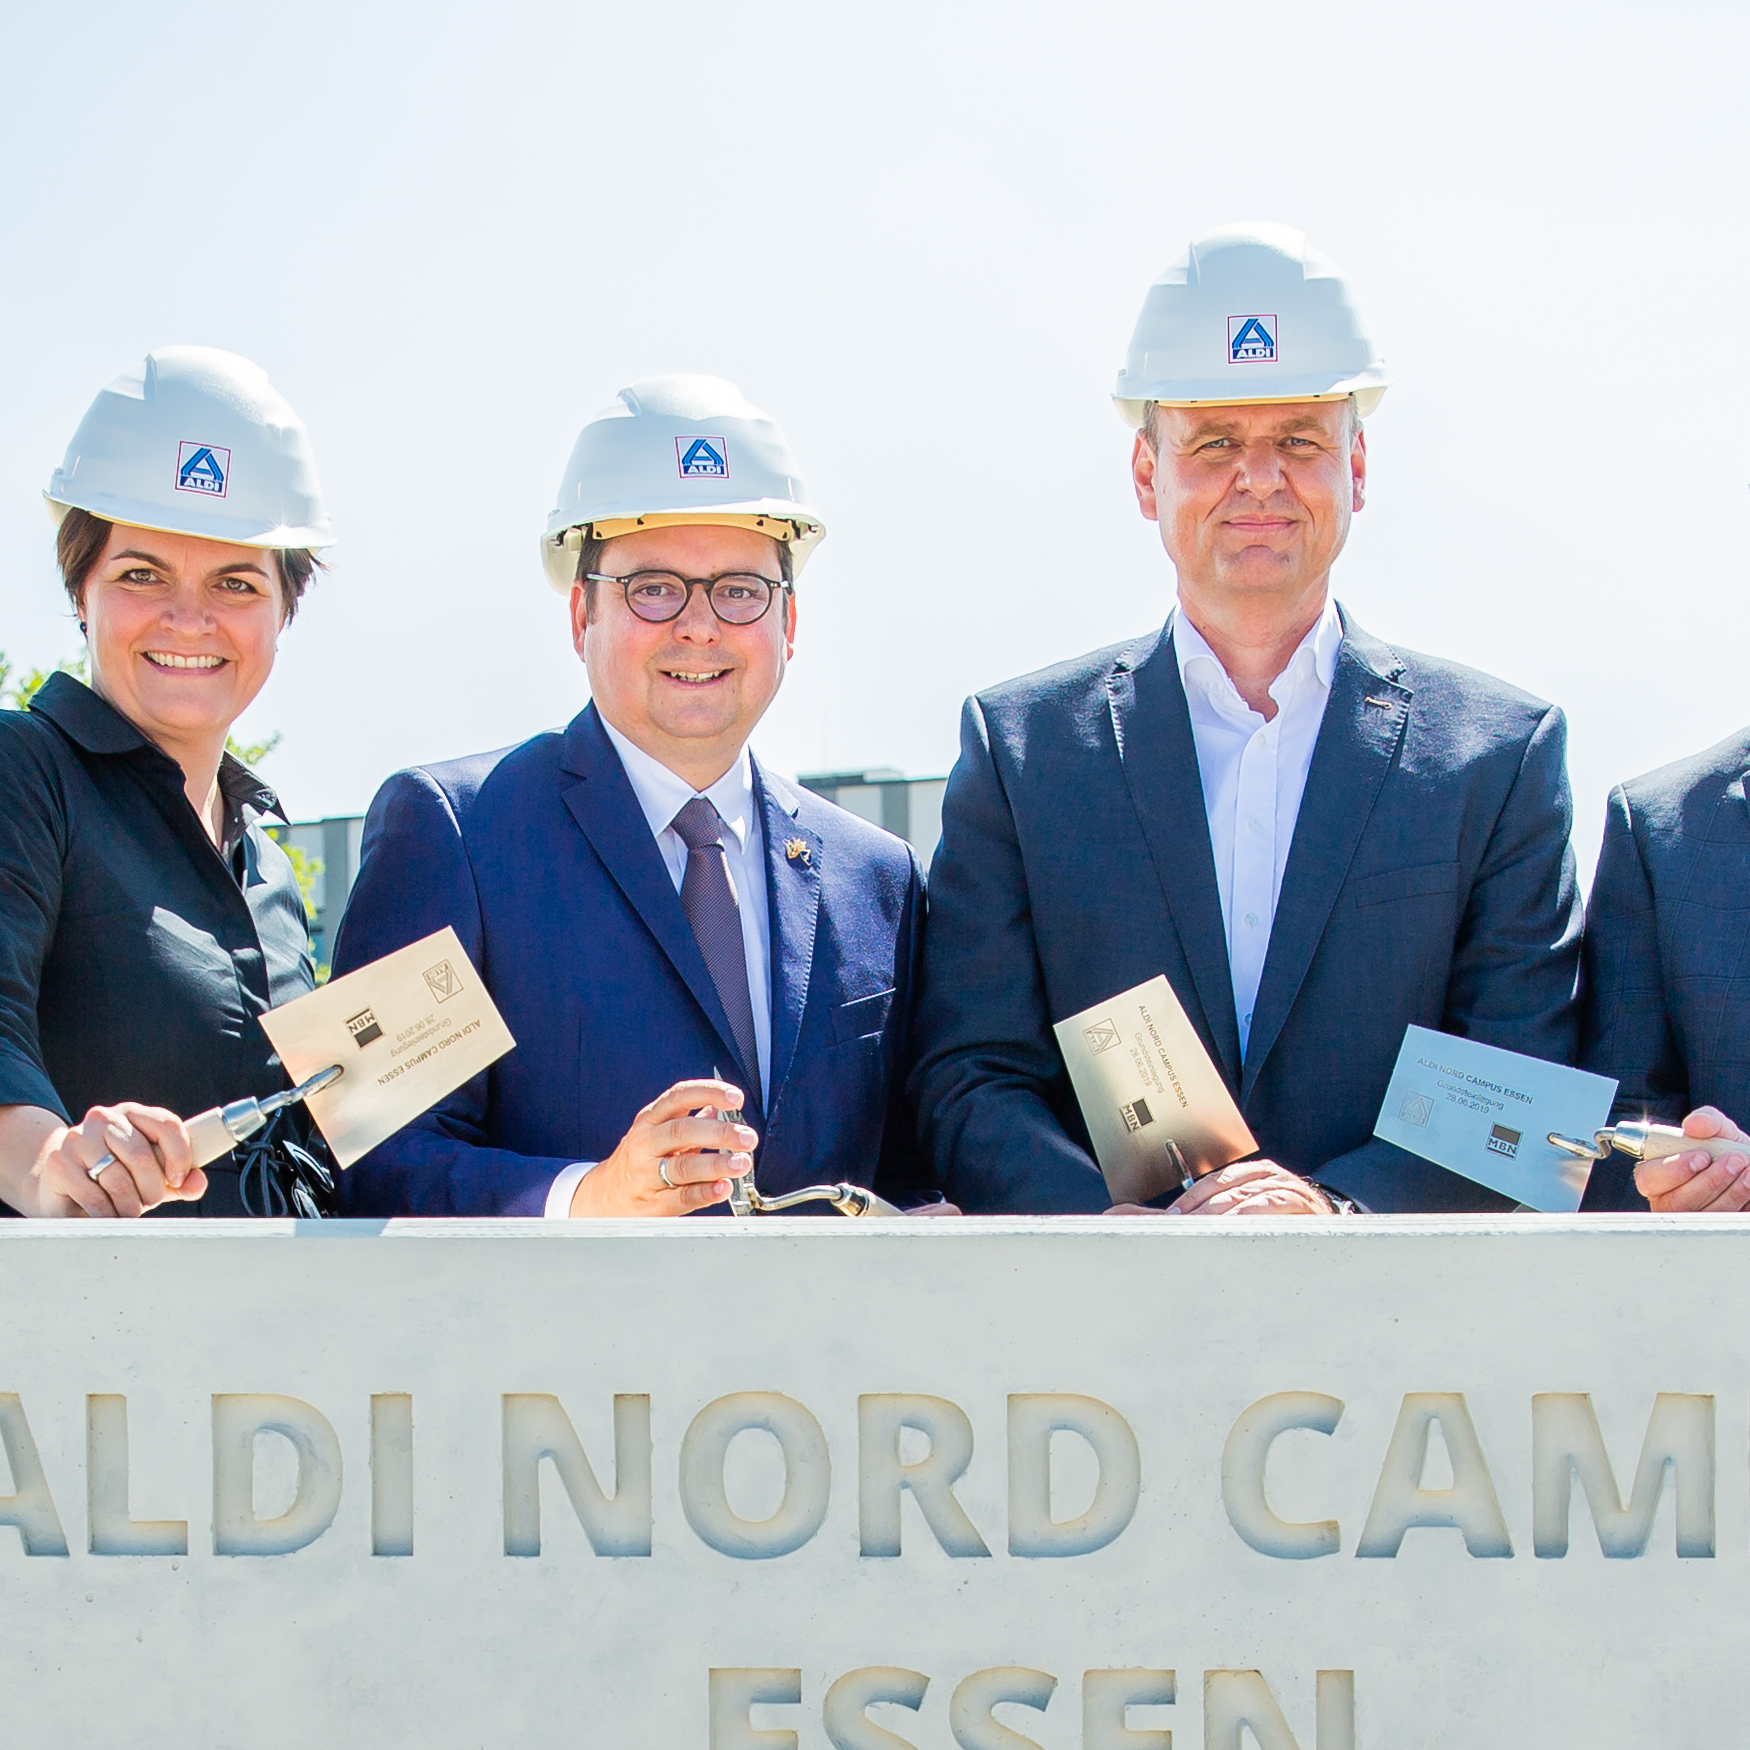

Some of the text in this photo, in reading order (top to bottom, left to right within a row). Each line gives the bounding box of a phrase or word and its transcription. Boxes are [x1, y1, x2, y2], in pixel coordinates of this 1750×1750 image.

[1236, 348, 1271, 359] ALDI
[687, 465, 722, 474] ALDI
[183, 477, 220, 492] ALDI
[348, 1012, 375, 1033] MBN
[389, 1017, 452, 1057] Grundsteinlegung
[377, 1019, 481, 1086] ALDI NORD CAMPUS ESSEN
[1139, 1005, 1189, 1108] ALDI NORD CAMPUS ESSEN
[1417, 1058, 1534, 1105] ALDI NORD CAMPUS ESSEN
[1436, 1079, 1504, 1111] Grundsteinlegung
[1445, 1093, 1490, 1114] 28.06.2019
[1123, 1104, 1140, 1131] MBN
[1488, 1138, 1518, 1154] MBN
[500, 1389, 1142, 1561] NORD
